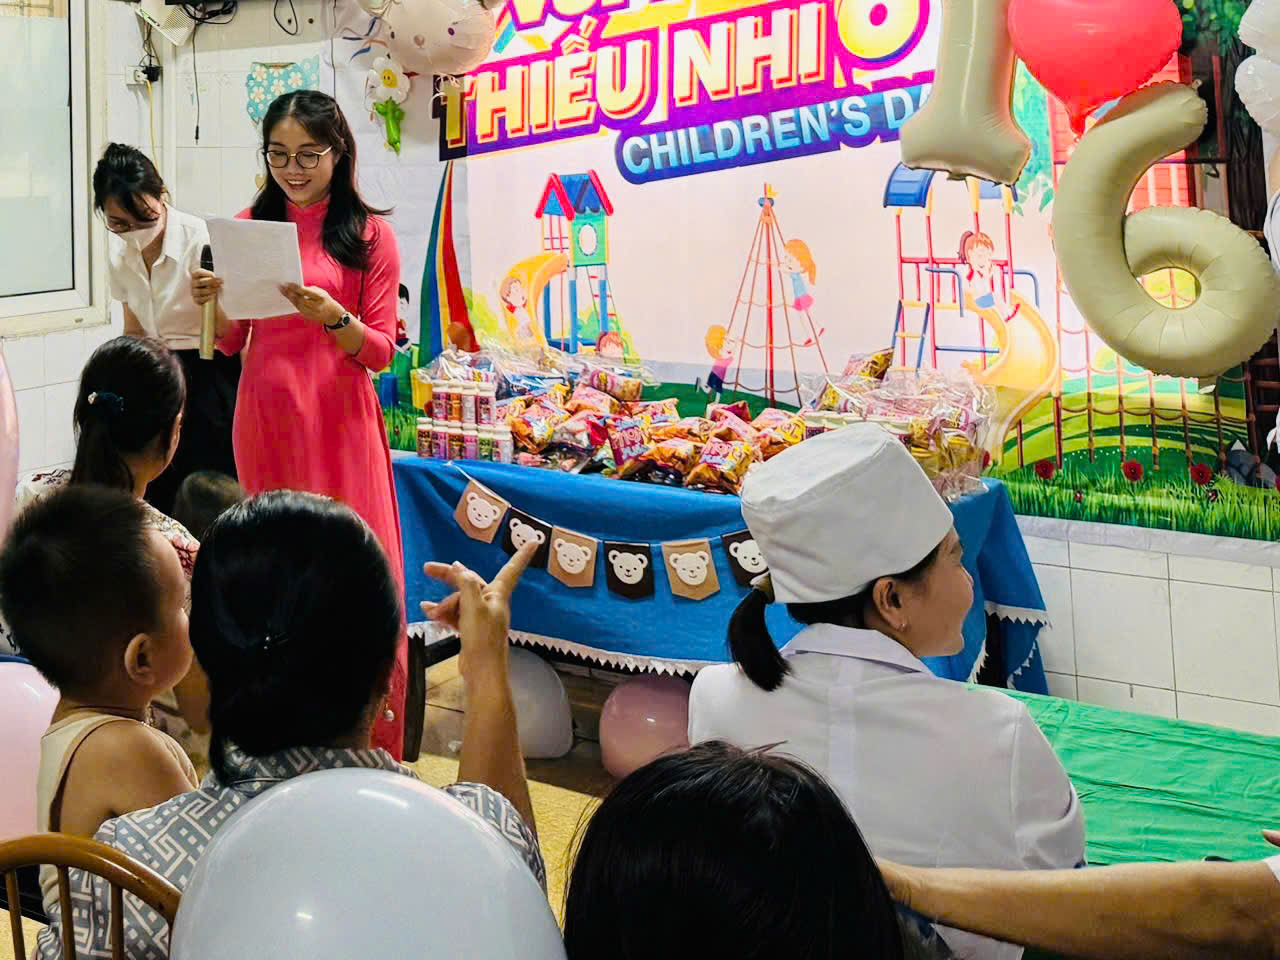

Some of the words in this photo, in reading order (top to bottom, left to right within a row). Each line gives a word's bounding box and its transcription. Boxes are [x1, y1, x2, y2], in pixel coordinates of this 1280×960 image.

[440, 15, 650, 147] THIẾU
[673, 2, 825, 106] NHI
[622, 96, 872, 176] CHILDREN'S
